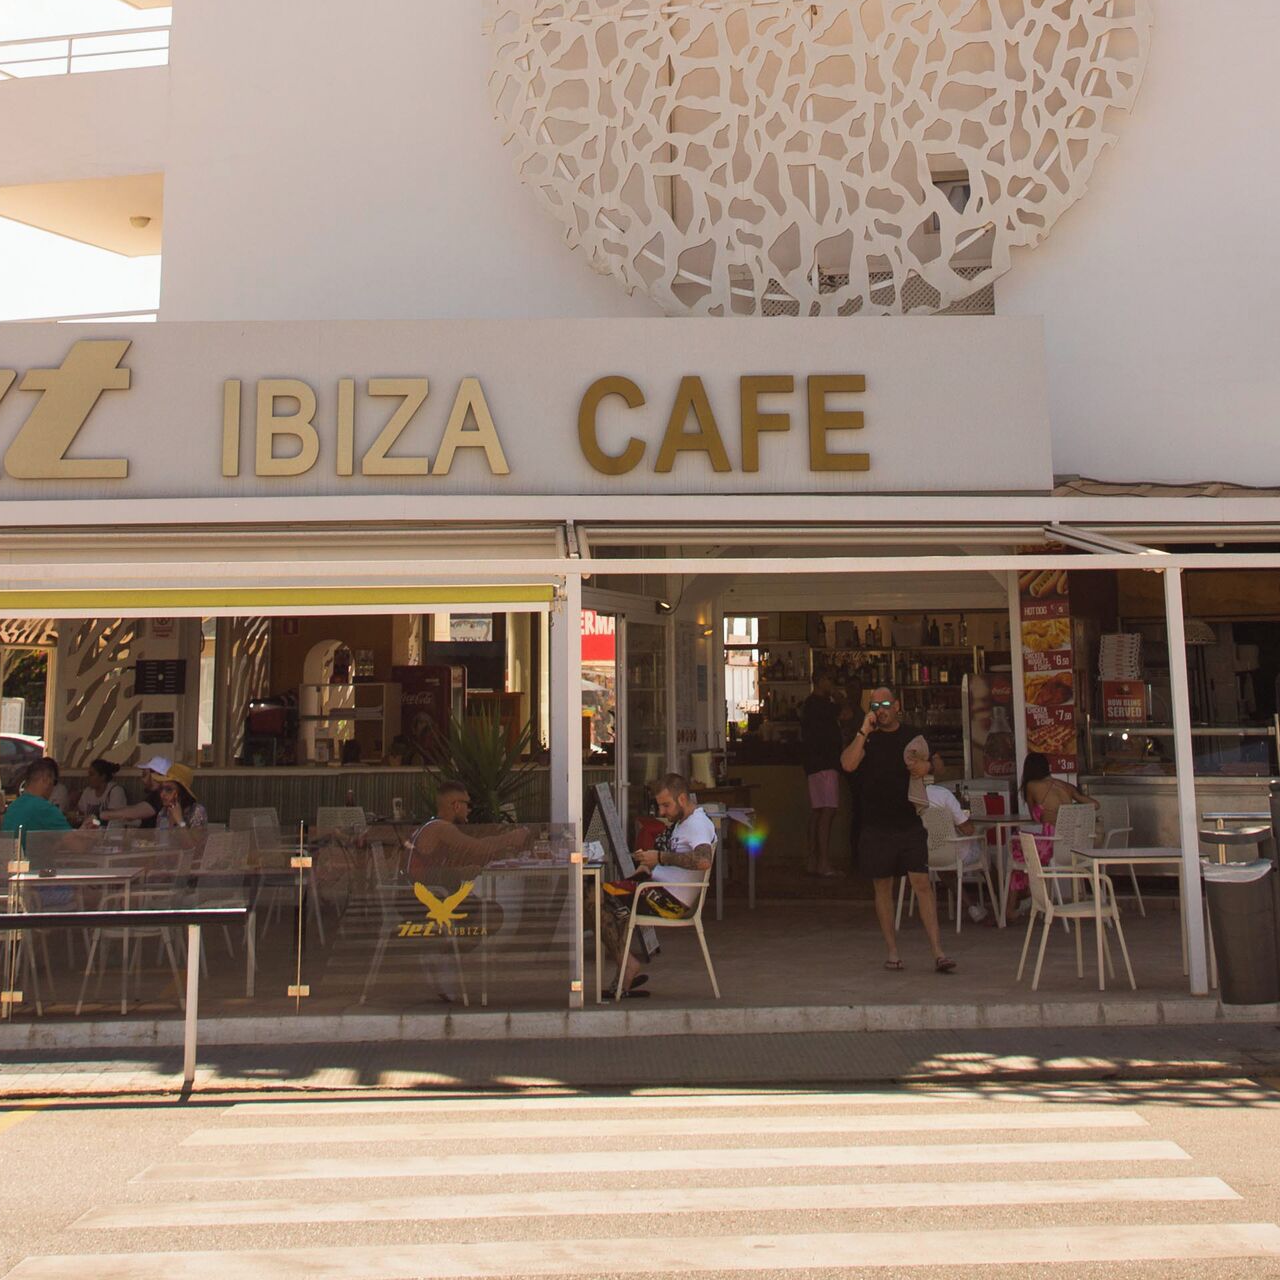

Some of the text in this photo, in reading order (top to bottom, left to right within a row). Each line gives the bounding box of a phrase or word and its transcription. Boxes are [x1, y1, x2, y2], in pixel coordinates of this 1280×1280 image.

[222, 377, 511, 477] IBIZA
[577, 374, 871, 476] CAFE
[1107, 706, 1142, 718] SERVED
[454, 926, 488, 936] IBIZA
